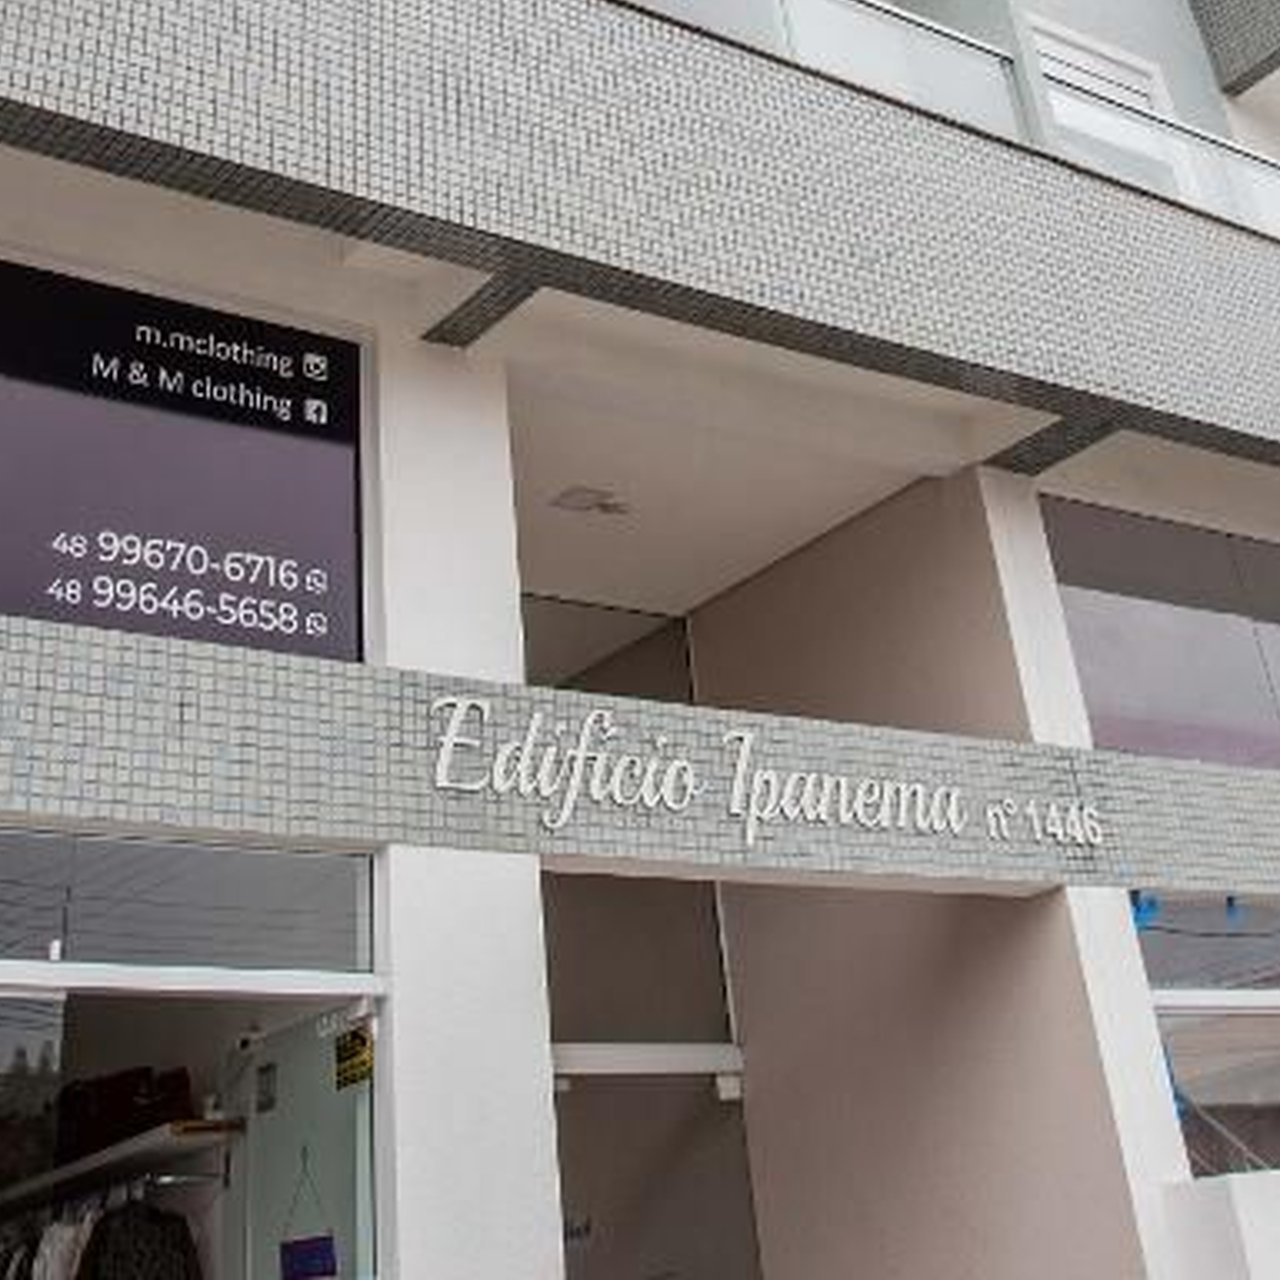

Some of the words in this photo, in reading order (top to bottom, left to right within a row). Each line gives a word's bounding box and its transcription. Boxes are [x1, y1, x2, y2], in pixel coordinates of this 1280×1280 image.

[135, 324, 294, 379] m.mclothing
[91, 352, 121, 382] M
[127, 360, 150, 388] &
[158, 366, 185, 394] M
[191, 376, 293, 421] clothing
[51, 531, 88, 558] 48
[96, 530, 300, 592] 99670-6716
[45, 578, 82, 605] 48
[91, 575, 299, 635] 99646-5658
[721, 730, 968, 847] Ipanema
[1024, 799, 1103, 847] 1446
